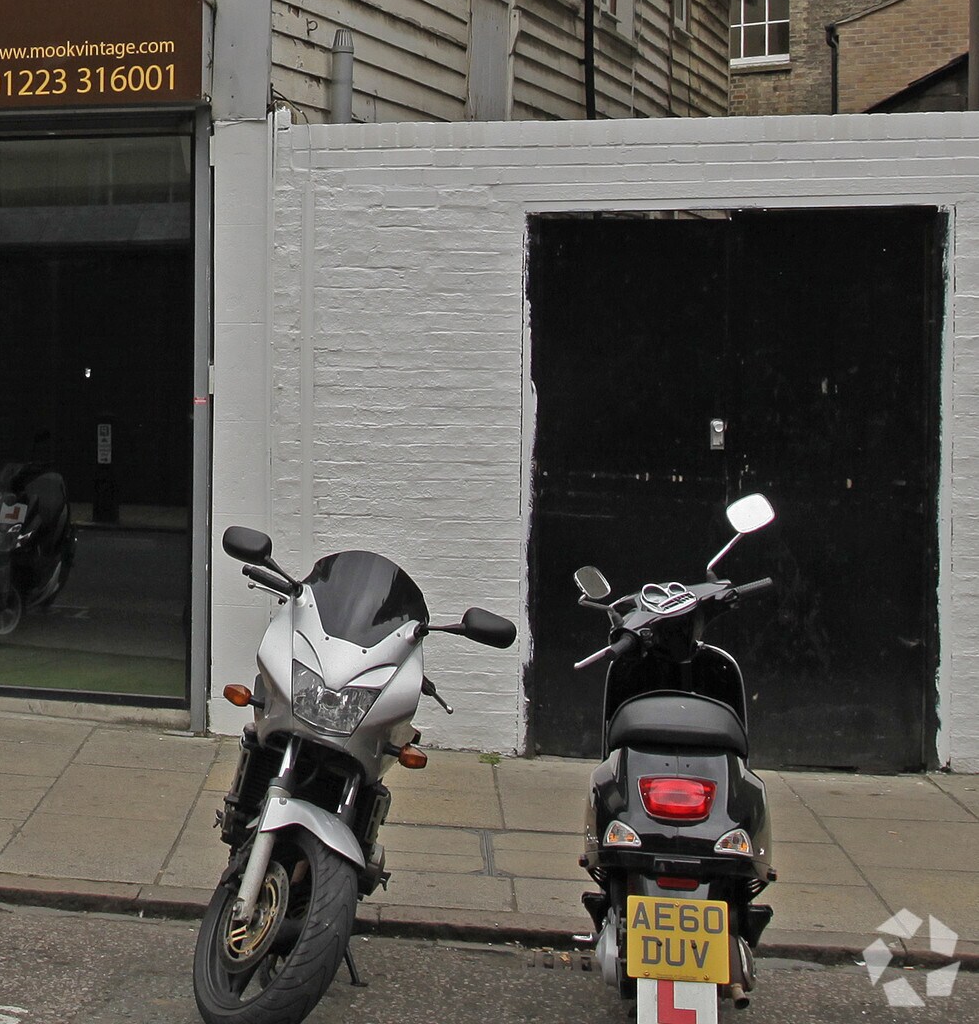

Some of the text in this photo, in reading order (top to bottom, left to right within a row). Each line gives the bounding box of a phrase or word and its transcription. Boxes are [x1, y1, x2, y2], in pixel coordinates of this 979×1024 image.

[76, 63, 176, 94] 316001
[632, 902, 724, 934] AE60
[641, 936, 710, 968] DUV
